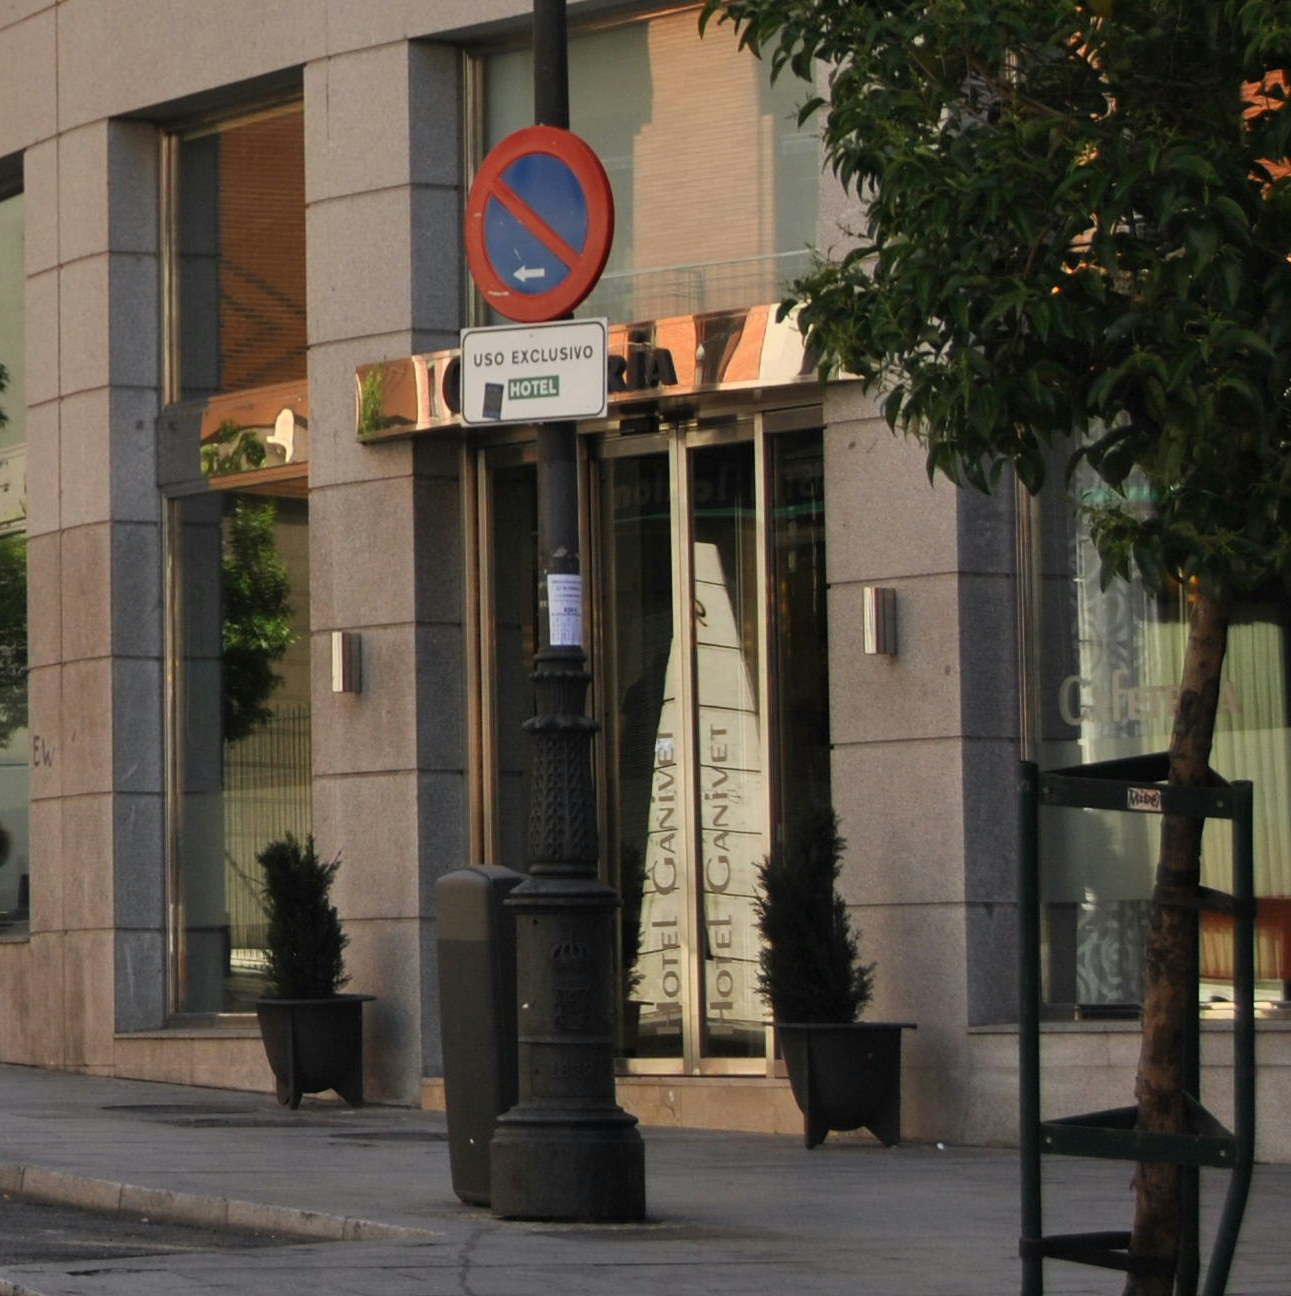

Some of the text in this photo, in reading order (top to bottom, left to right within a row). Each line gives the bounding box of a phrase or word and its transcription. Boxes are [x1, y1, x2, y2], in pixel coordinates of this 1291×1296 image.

[473, 345, 594, 368] USO EXCLUSIVO
[509, 378, 558, 398] HOTEL
[652, 915, 681, 1035] HOTEL
[707, 913, 734, 1035] HOTEL
